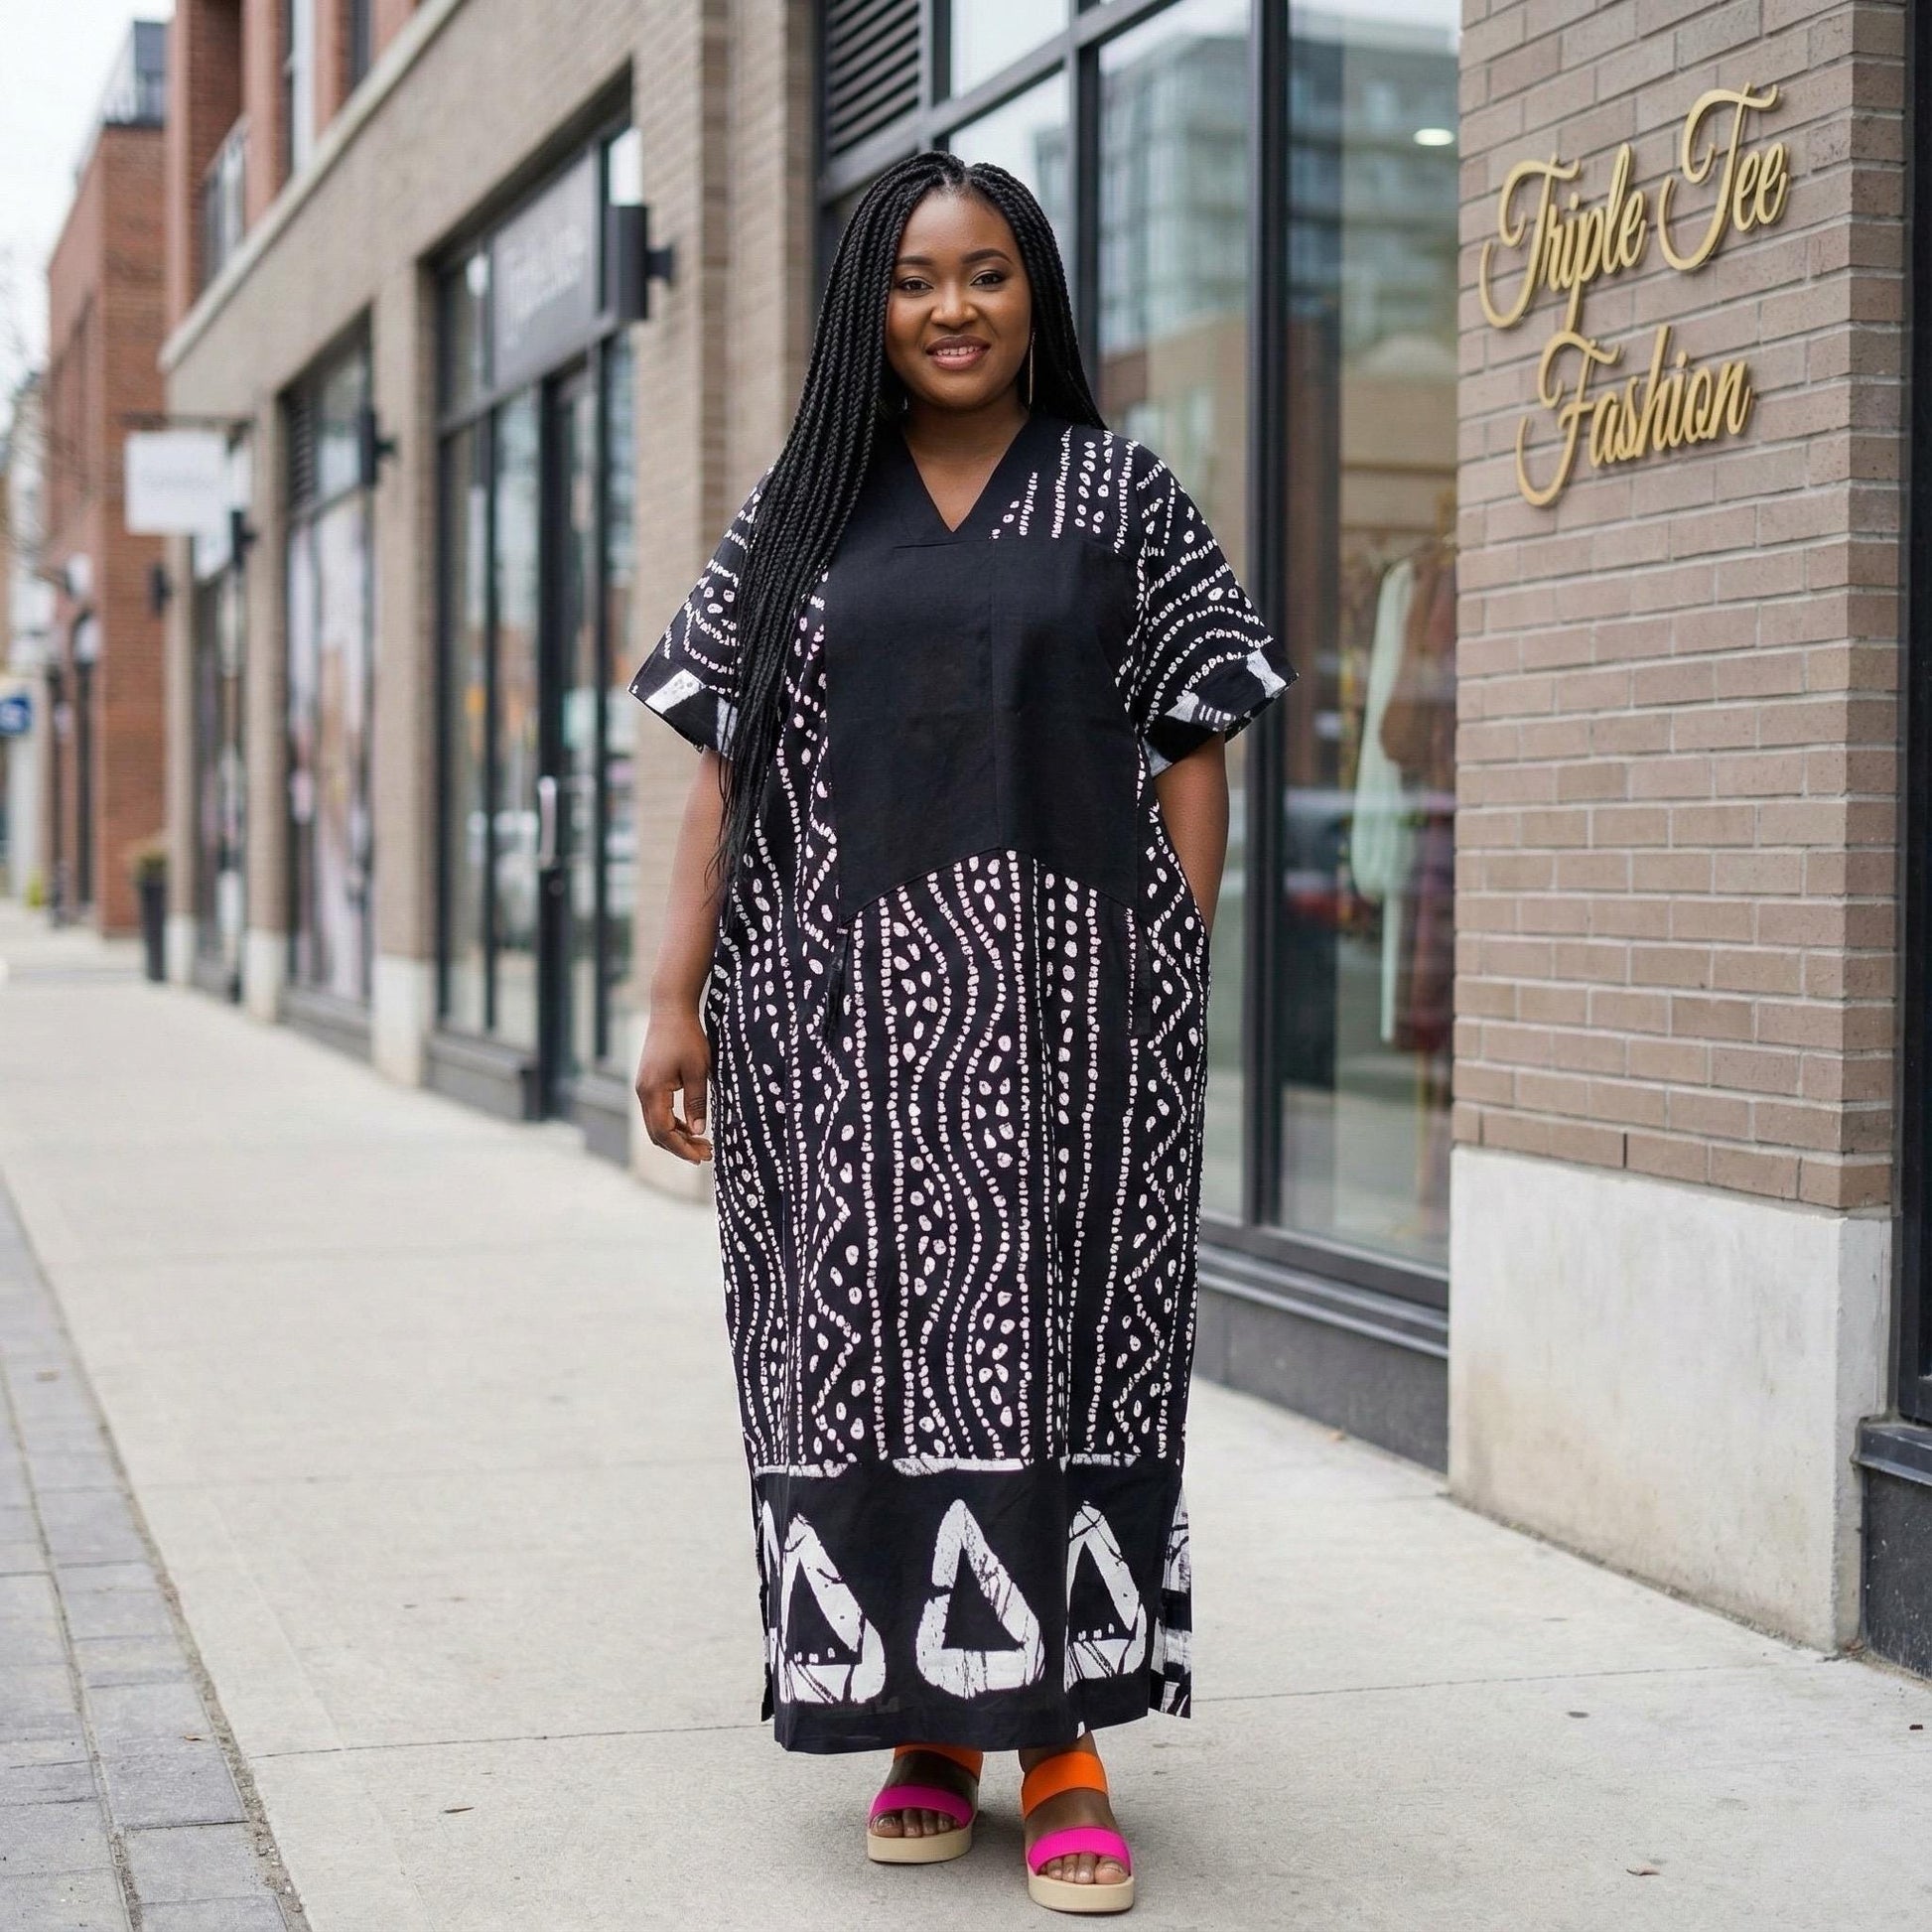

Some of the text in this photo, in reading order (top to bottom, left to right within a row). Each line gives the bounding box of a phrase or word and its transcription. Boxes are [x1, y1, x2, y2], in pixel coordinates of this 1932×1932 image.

[1479, 81, 1788, 332] Triple Tee
[1515, 324, 1753, 507] Fashion
